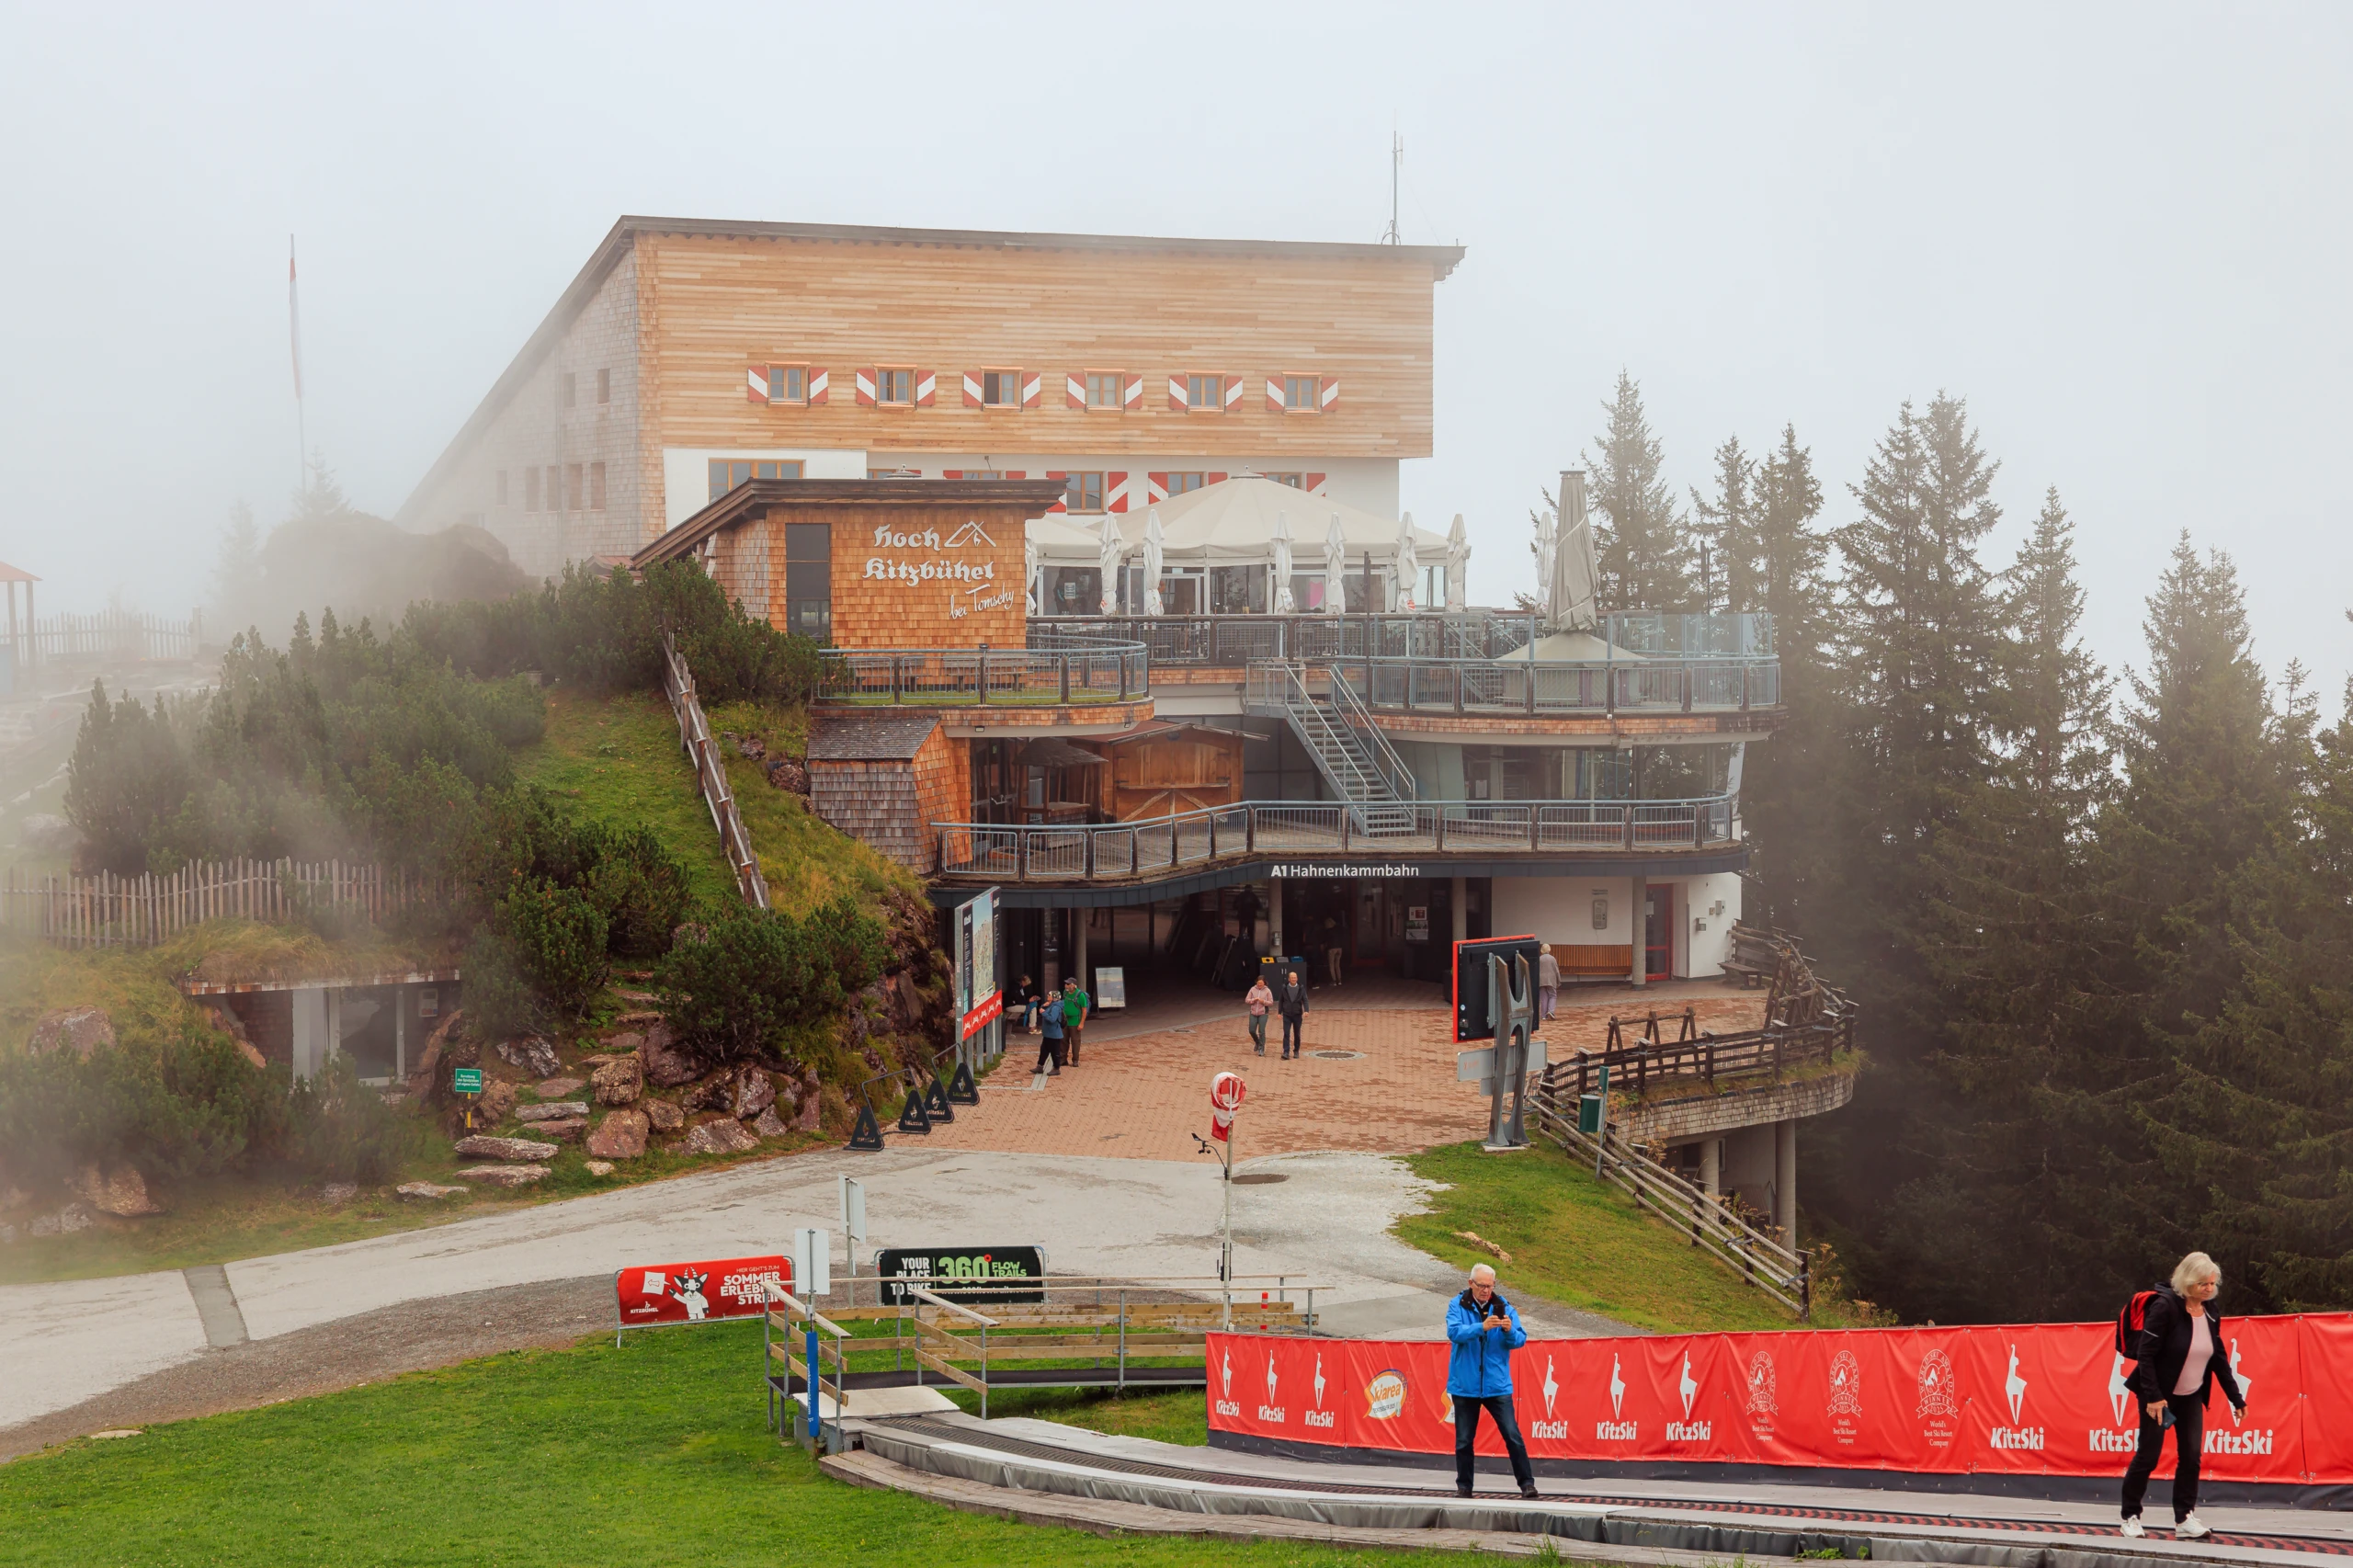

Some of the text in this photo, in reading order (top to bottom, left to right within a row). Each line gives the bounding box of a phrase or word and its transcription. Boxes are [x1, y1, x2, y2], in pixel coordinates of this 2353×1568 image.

[862, 557, 995, 586] Kitzbühel
[949, 582, 1015, 620] bei Tomschy
[1271, 864, 1419, 877] A1 Hahnenkammbahn
[901, 1257, 930, 1270] YOUR
[992, 1261, 1020, 1269] FLOW
[723, 1272, 781, 1286] SOMMER
[992, 1268, 1027, 1277] TRAILS
[1216, 1399, 1239, 1416] KitzSki
[1258, 1404, 1285, 1423] KitzSki
[1305, 1410, 1334, 1427] KitzSki
[1531, 1420, 1568, 1439] KitzSki
[1597, 1420, 1637, 1440] KitzSki
[1665, 1420, 1711, 1441] KitzSki
[1924, 1429, 1932, 1437] Best
[1990, 1426, 2044, 1450] KitzSki
[1928, 1438, 1949, 1449] Company
[2203, 1429, 2273, 1455] KitzSki
